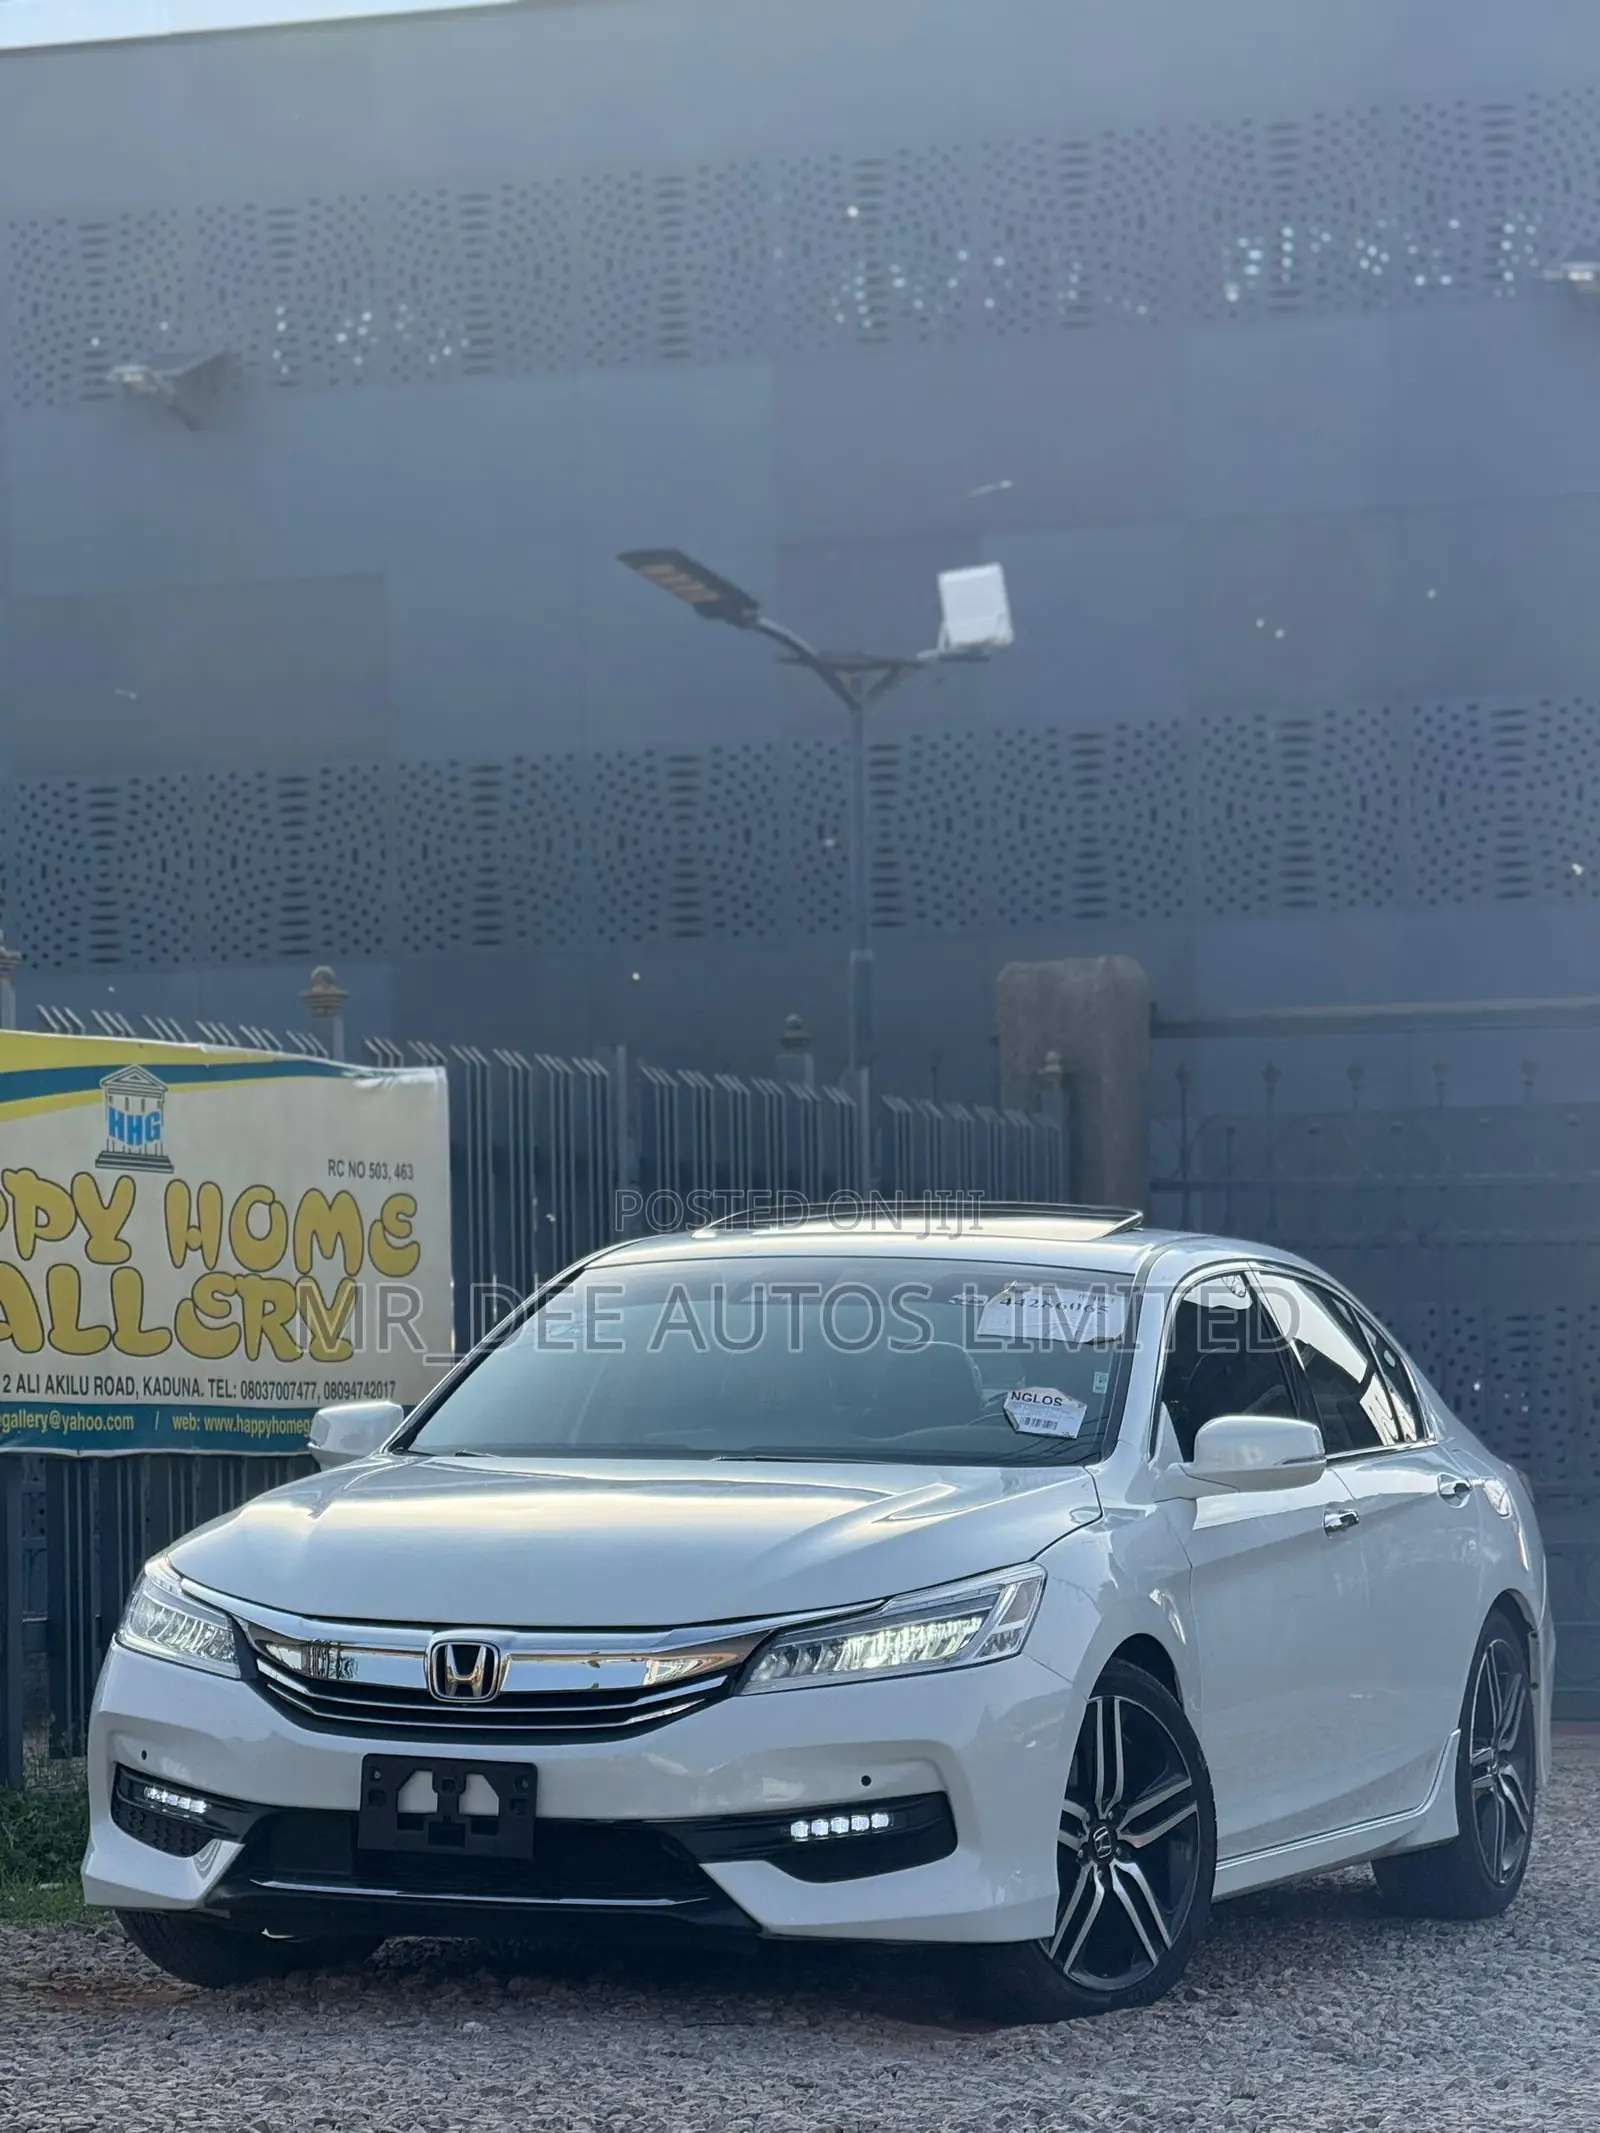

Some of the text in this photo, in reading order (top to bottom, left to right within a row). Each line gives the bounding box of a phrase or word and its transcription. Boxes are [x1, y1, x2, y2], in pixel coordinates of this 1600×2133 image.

[107, 1105, 162, 1146] HHG
[328, 1159, 414, 1184] RC NO 503, 463
[0, 1168, 421, 1278] PY HOME
[16, 1374, 40, 1395] ALI
[45, 1375, 89, 1397] AKILU
[94, 1376, 140, 1400] ROAD,
[143, 1376, 205, 1397] KADUNA.
[208, 1378, 237, 1398] TEL:
[240, 1379, 321, 1403] 08037007477,
[323, 1380, 397, 1400] 08094742017
[1011, 1391, 1063, 1407] NGLOS
[0, 1409, 134, 1435] gallery@yahoo.com
[172, 1412, 200, 1431] web:
